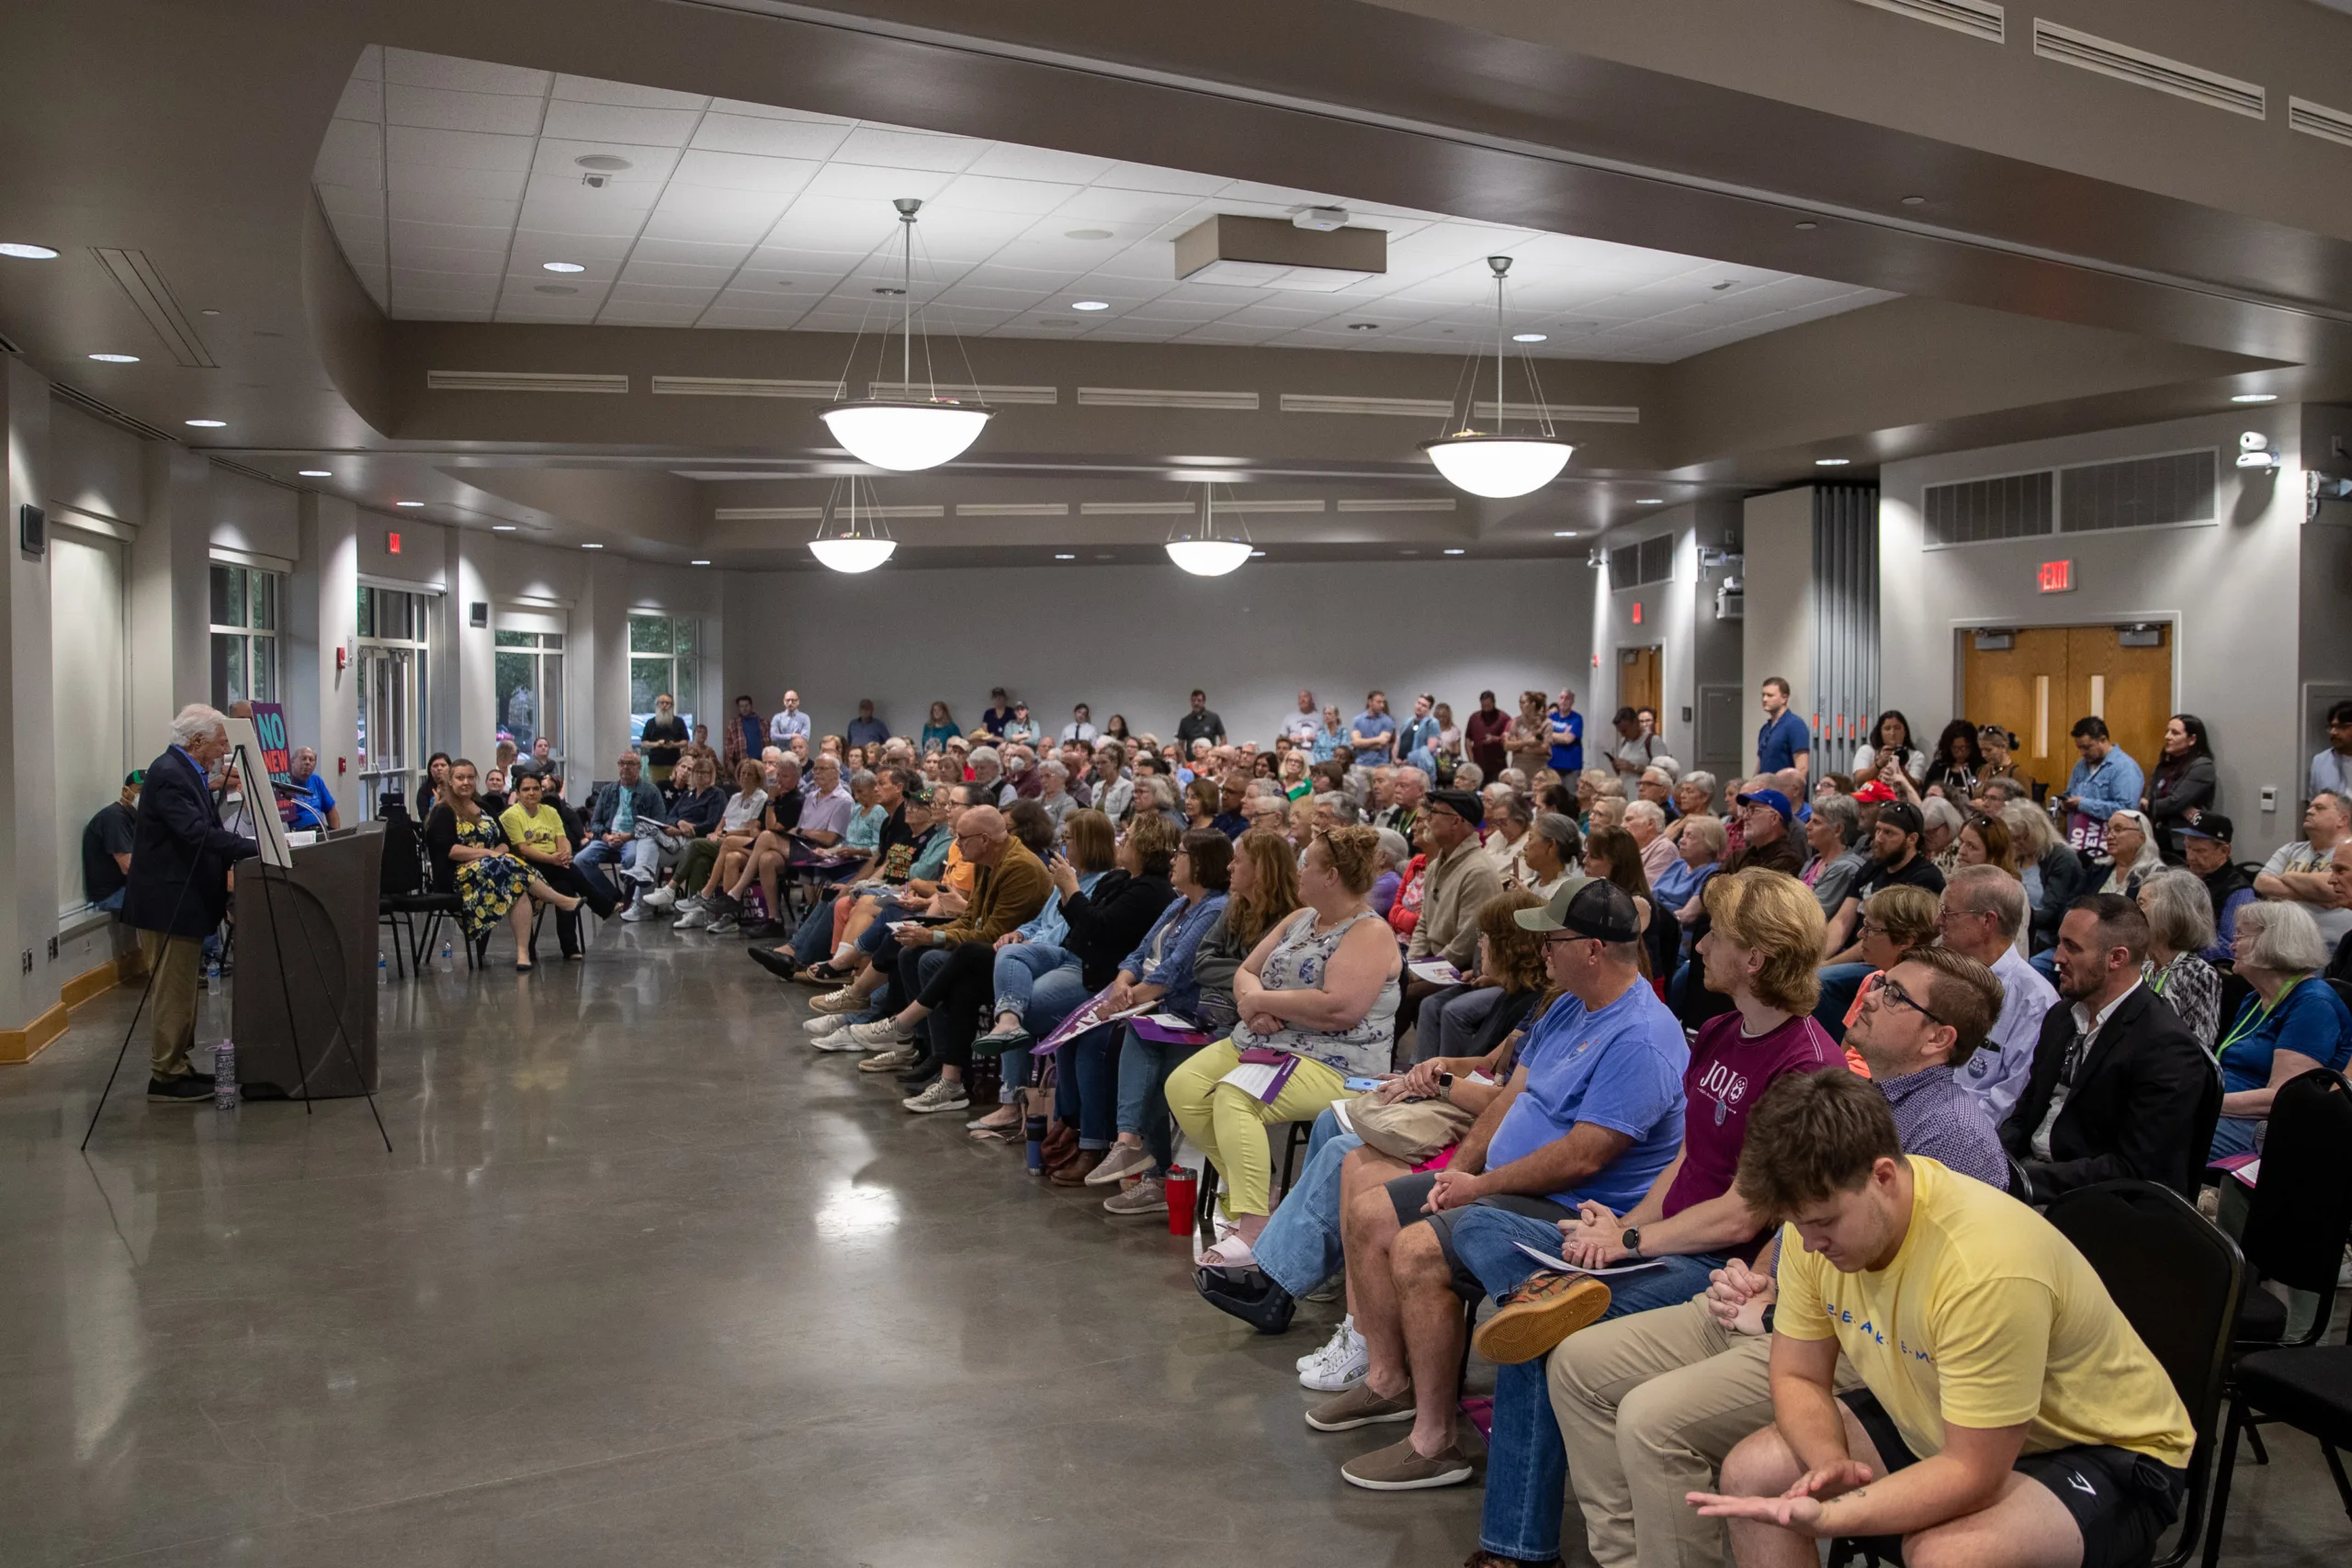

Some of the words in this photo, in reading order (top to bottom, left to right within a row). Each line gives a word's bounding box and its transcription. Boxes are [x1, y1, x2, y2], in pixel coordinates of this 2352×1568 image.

[2041, 560, 2069, 591] EXIT
[257, 712, 286, 750] NO
[263, 750, 288, 773] NEW
[2070, 827, 2086, 851] NO
